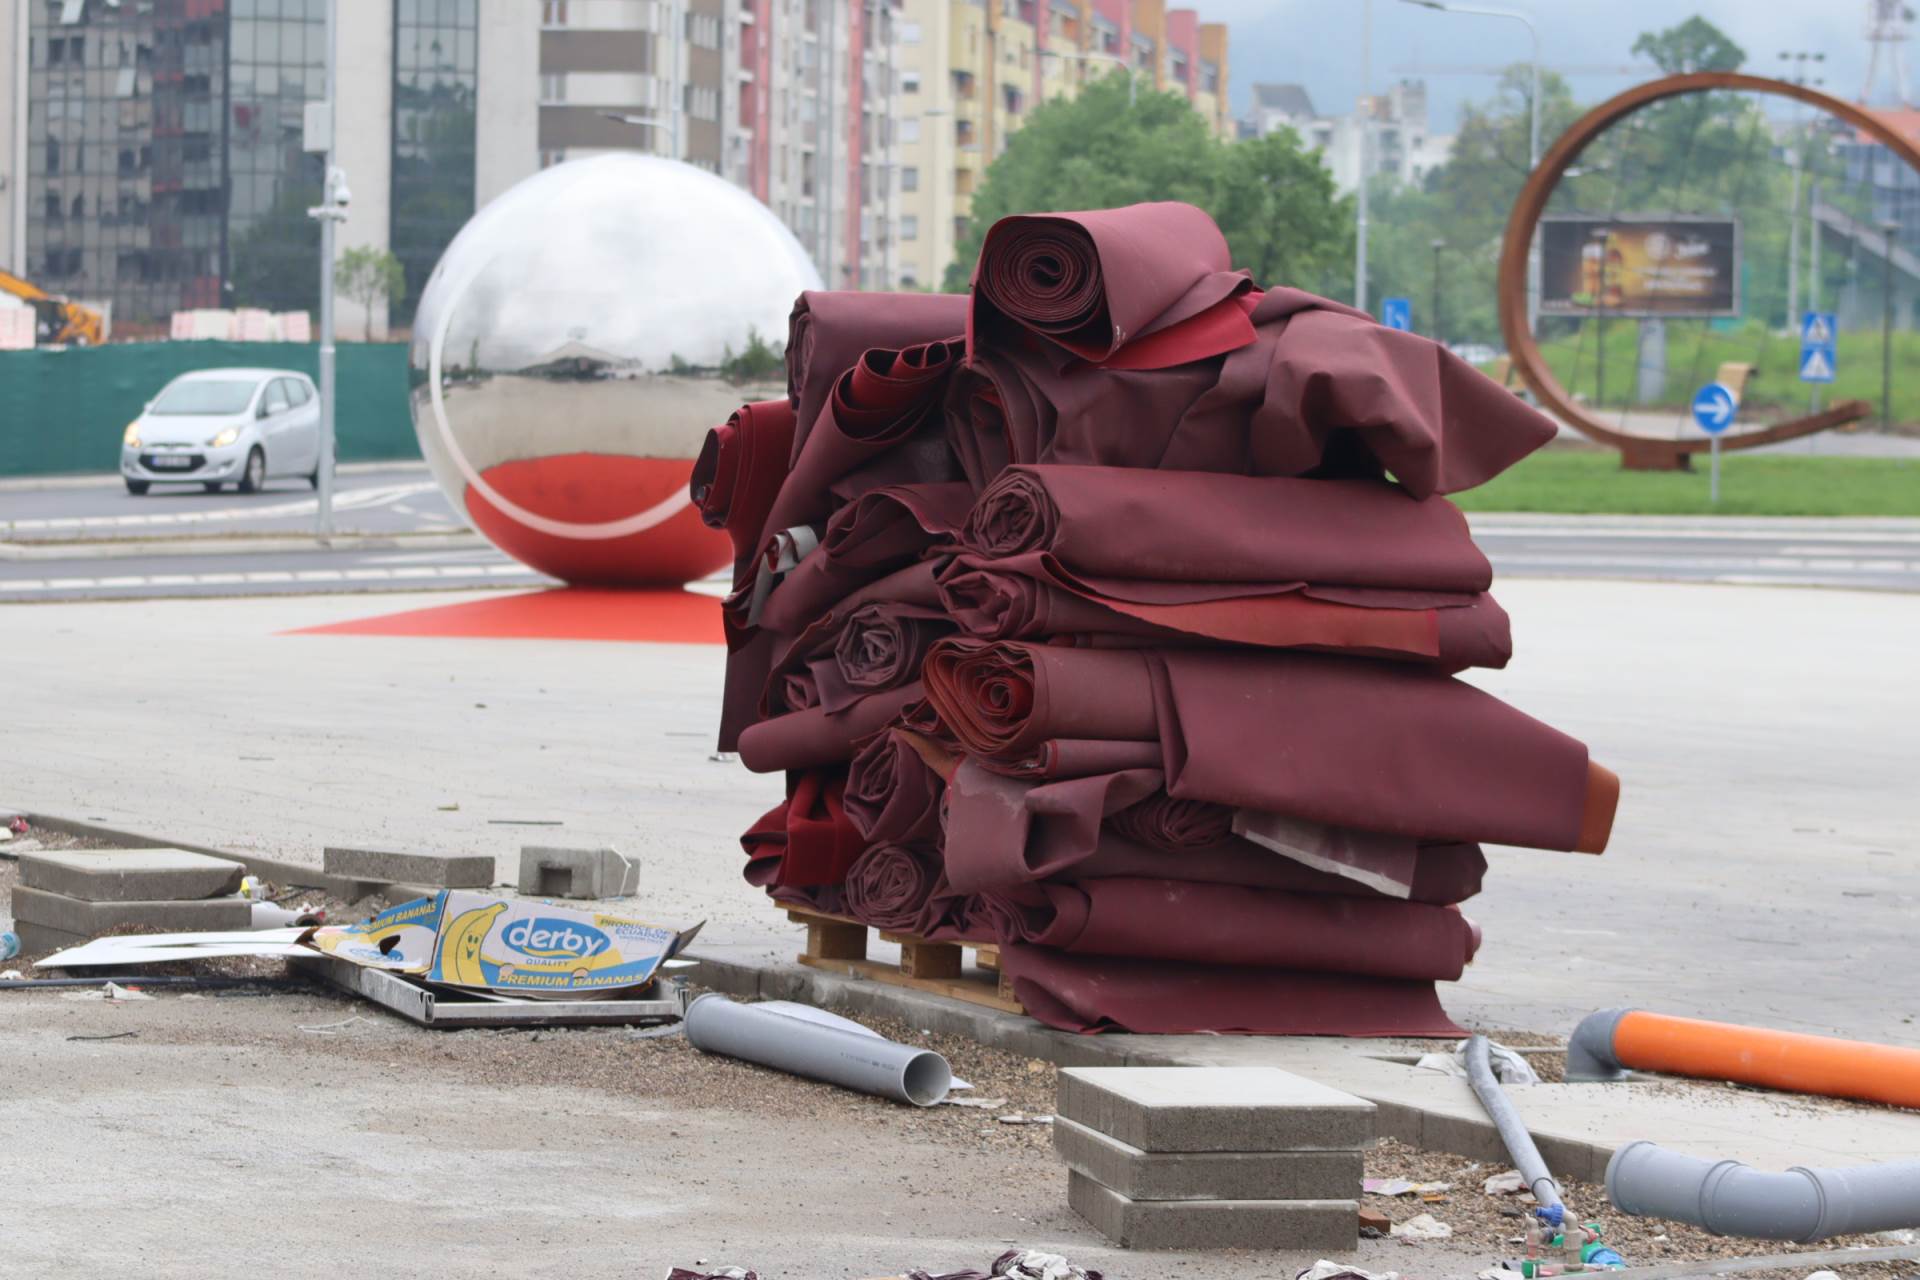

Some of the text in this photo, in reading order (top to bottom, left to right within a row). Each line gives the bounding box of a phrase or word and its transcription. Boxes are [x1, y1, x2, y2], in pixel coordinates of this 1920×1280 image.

[396, 903, 436, 922] BANANAS
[509, 915, 604, 957] derby
[615, 926, 668, 940] ECUADOR
[526, 959, 569, 968] QUALITY
[497, 974, 644, 987] PREMIUM BANANAS
